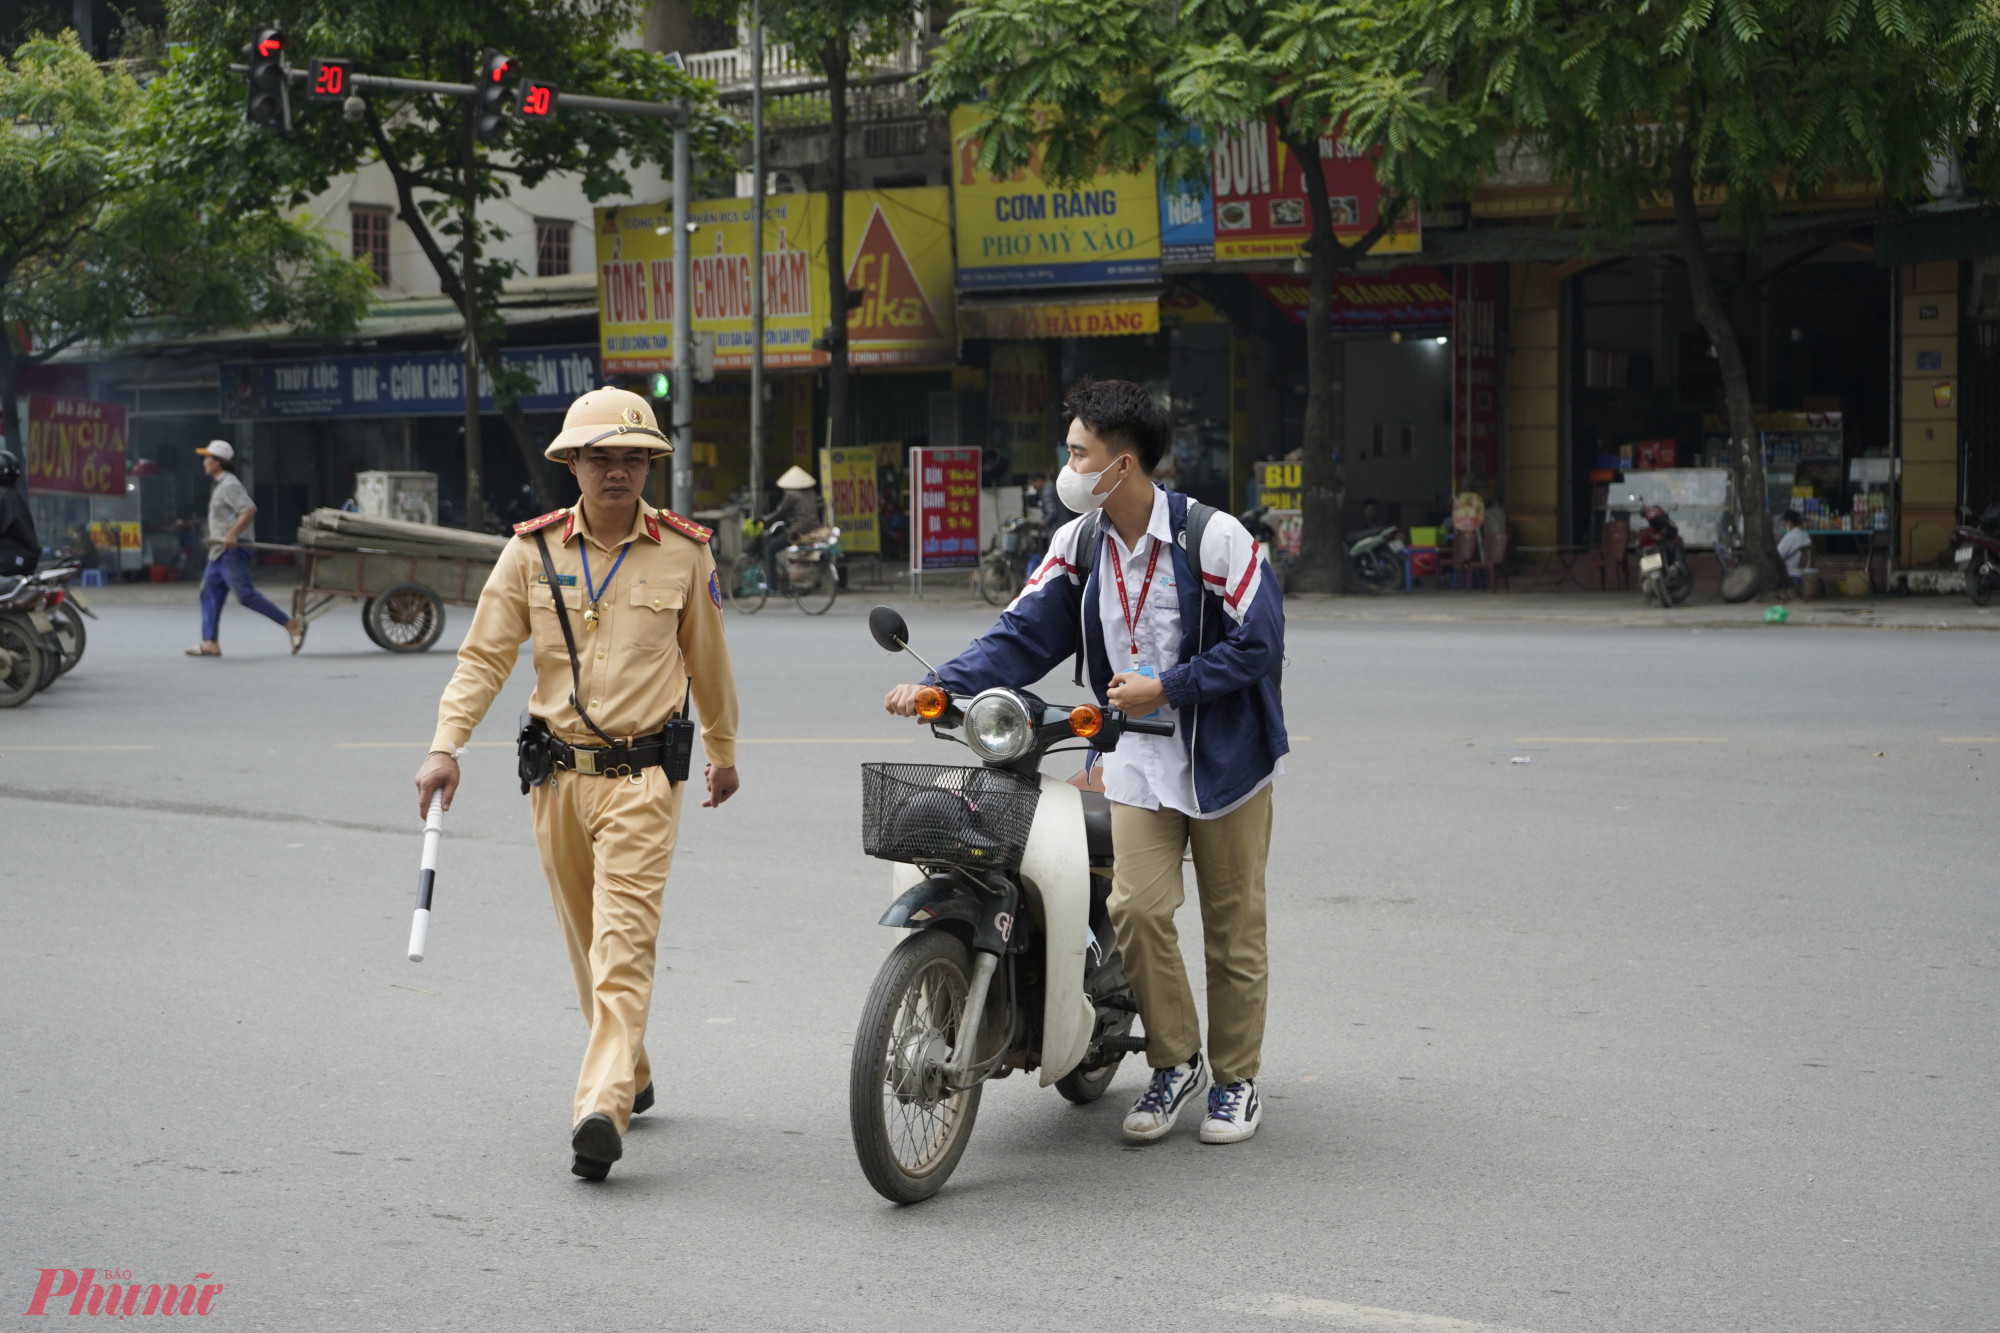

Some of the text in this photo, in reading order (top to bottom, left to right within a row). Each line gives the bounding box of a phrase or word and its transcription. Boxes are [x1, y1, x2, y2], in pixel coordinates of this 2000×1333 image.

[996, 190, 1116, 222] CƠM RANG
[982, 227, 1032, 257] PHỞ
[602, 235, 648, 323] TỔNG
[651, 260, 675, 322] KH
[692, 232, 752, 319] CHỐNG
[847, 253, 925, 329] Sika
[1045, 309, 1081, 333] HẢI
[1087, 306, 1143, 331] ĐĂNG
[30, 405, 74, 478] BÚN
[77, 420, 125, 452] CUA
[82, 451, 112, 491] ỐC
[1265, 464, 1301, 488] BU
